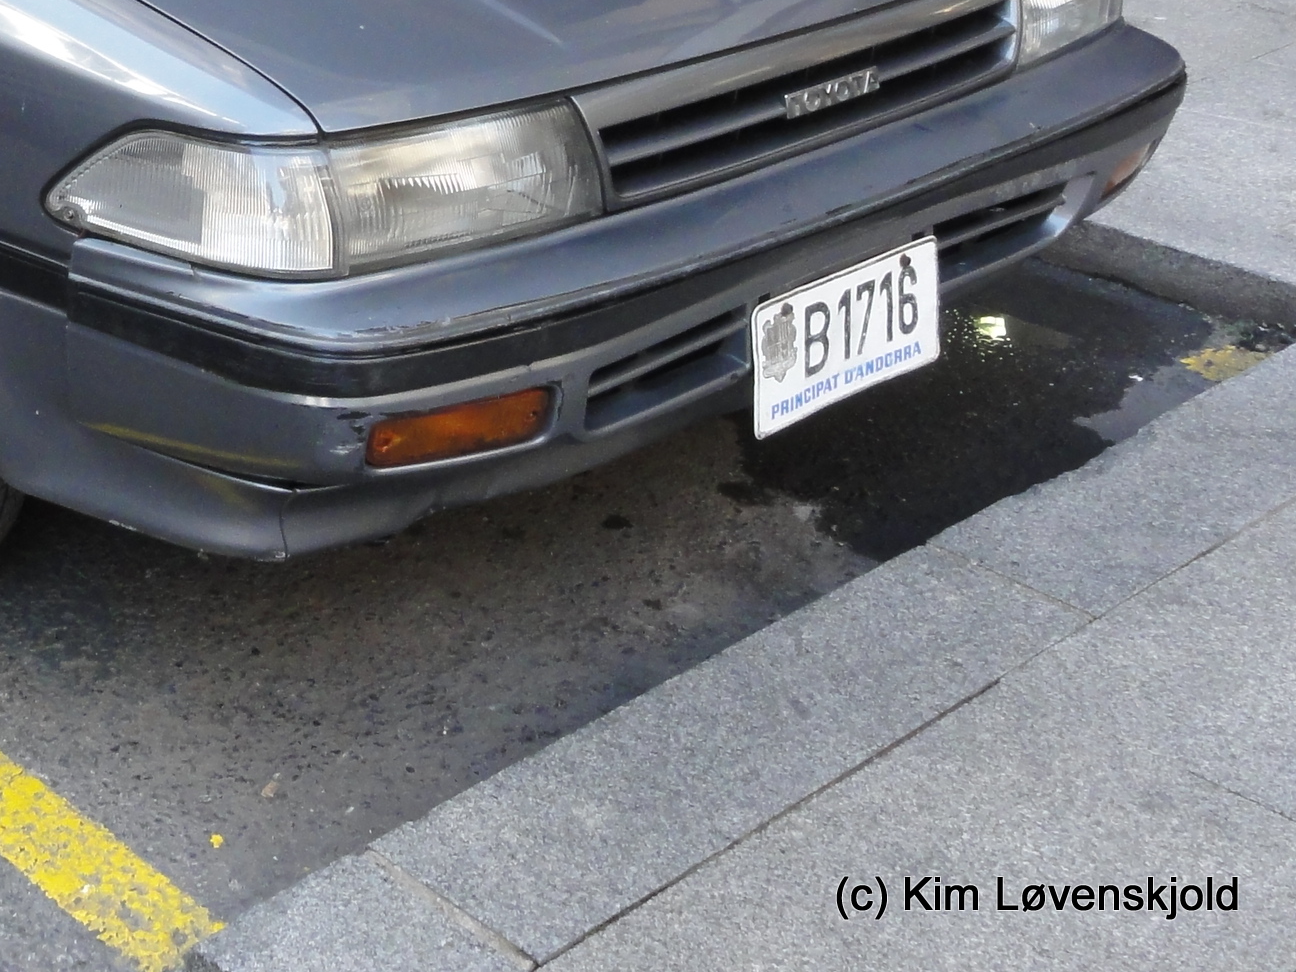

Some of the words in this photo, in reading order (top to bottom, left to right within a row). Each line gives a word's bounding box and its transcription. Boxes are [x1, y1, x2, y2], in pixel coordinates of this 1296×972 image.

[785, 66, 880, 119] TOYOTA
[804, 264, 919, 379] B1716
[771, 372, 841, 420] PRINCIPAT
[844, 340, 922, 386] D'ANDORRA
